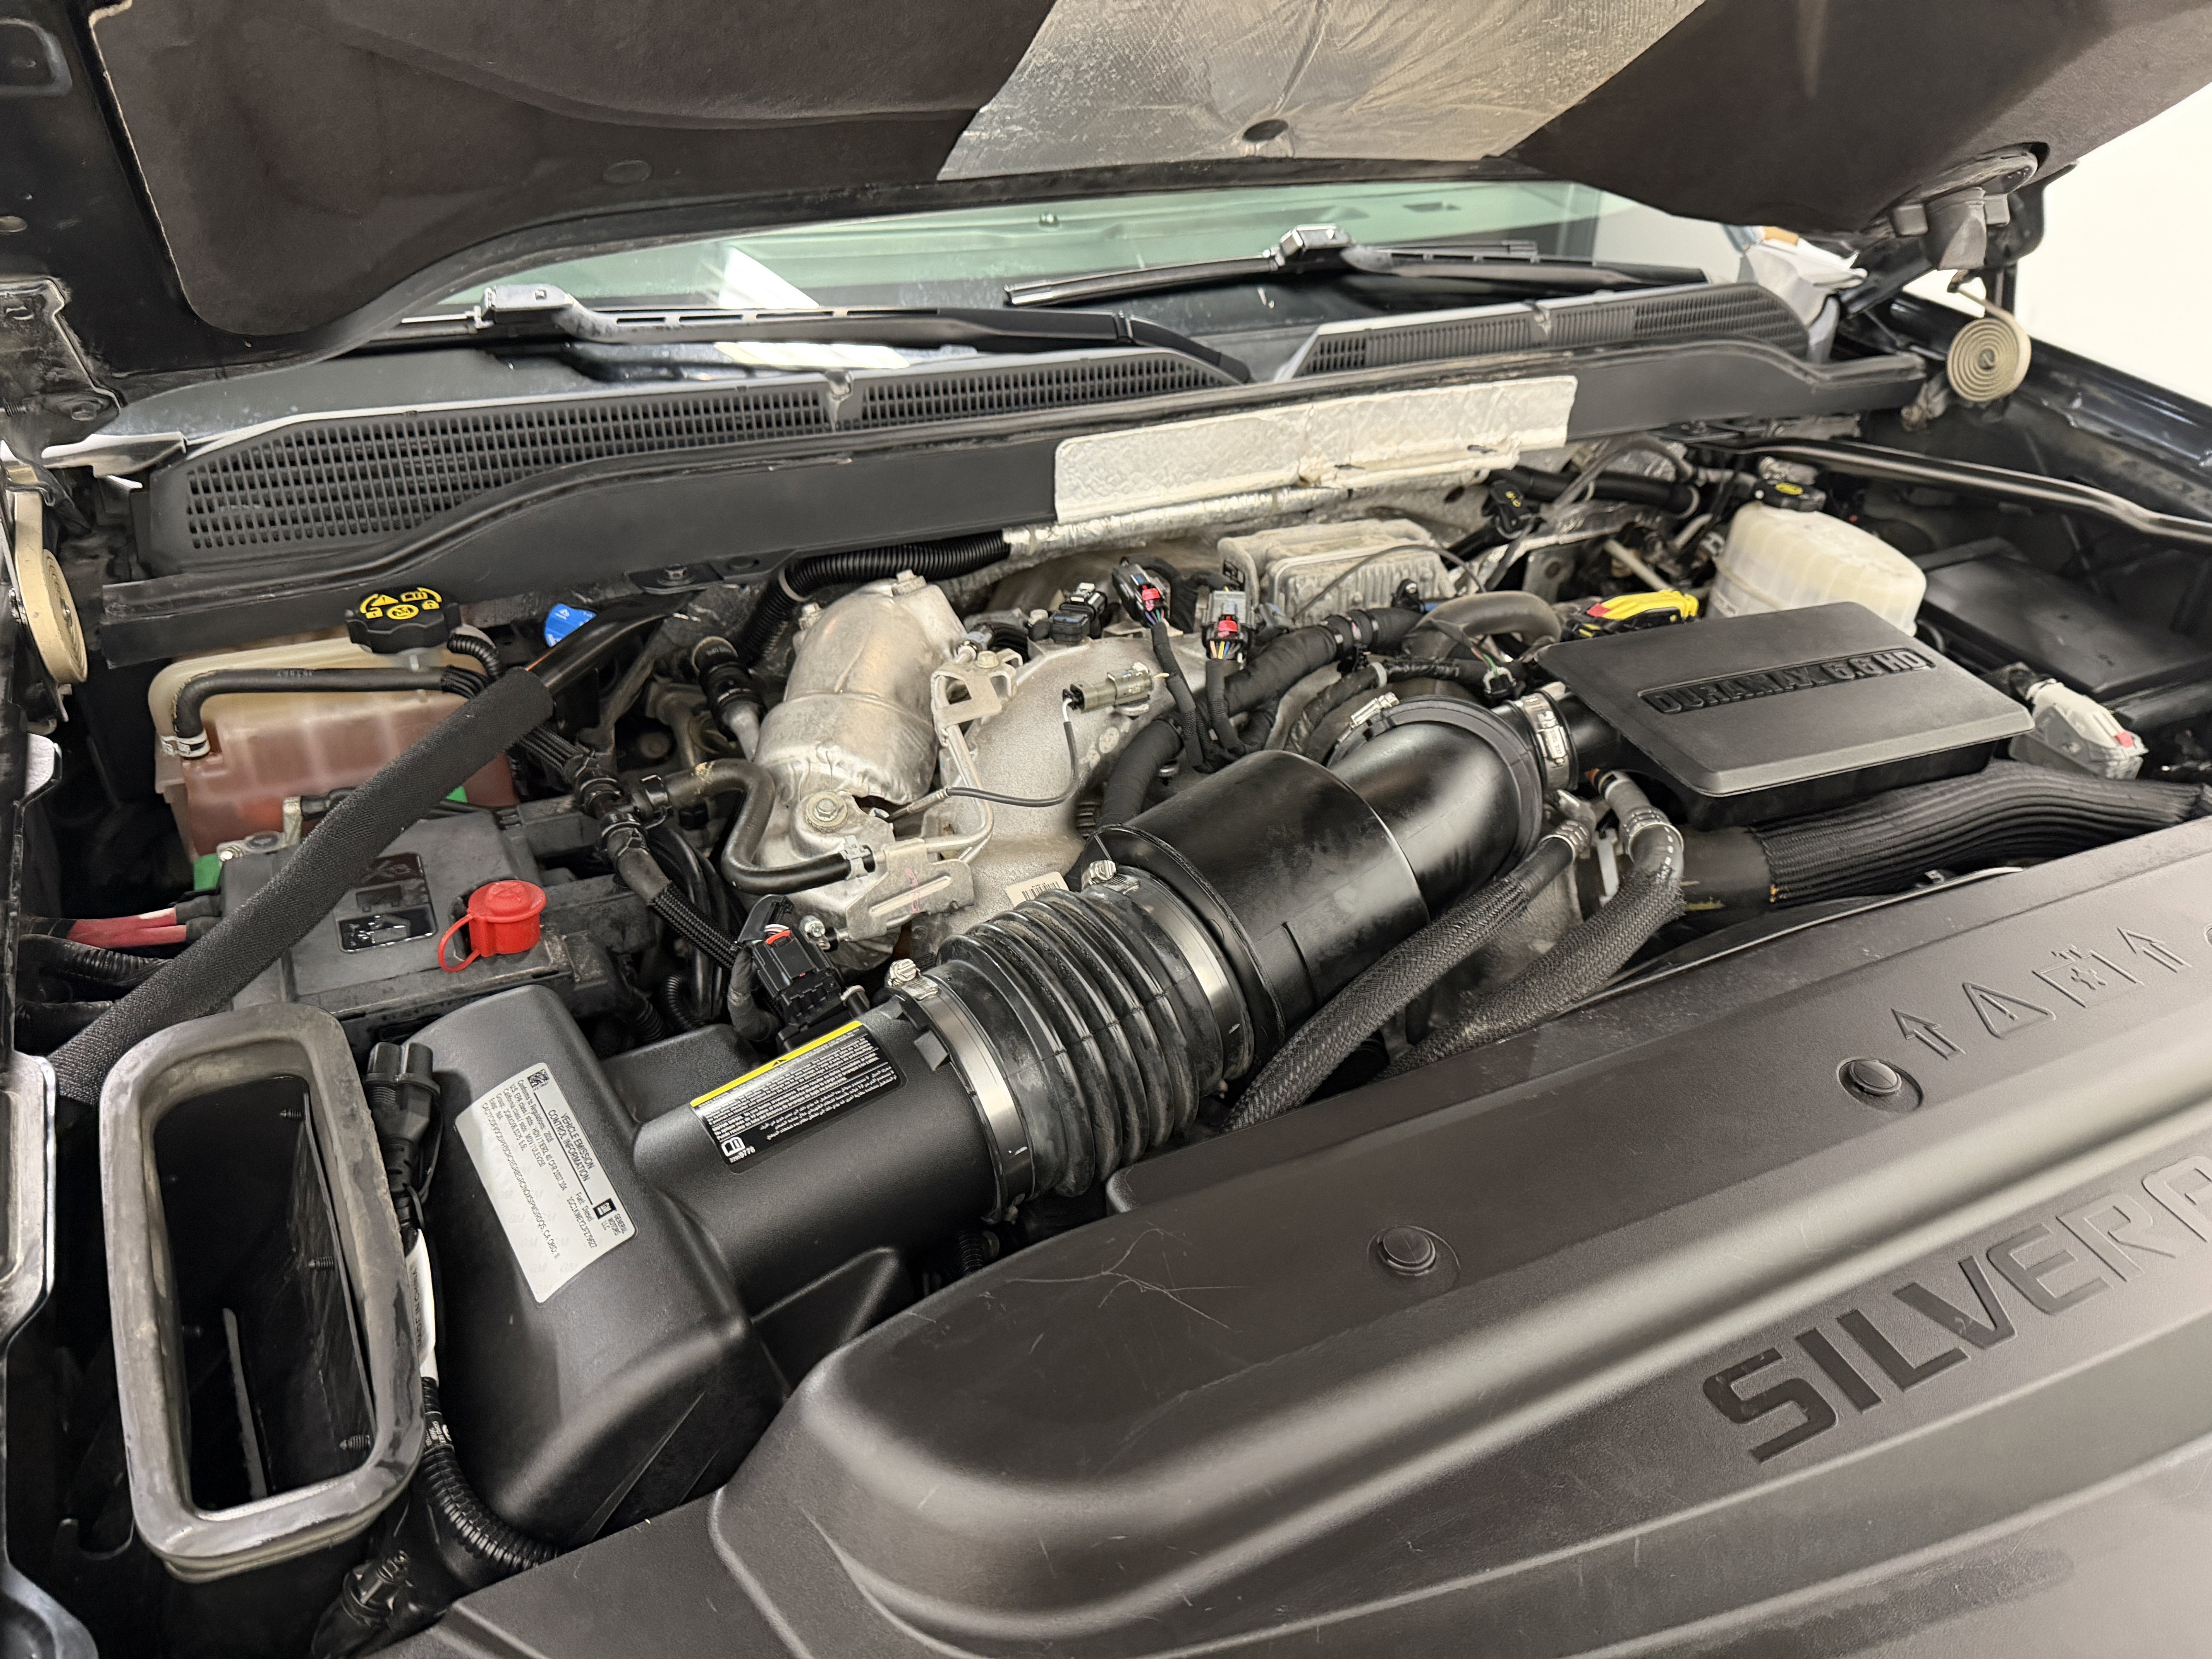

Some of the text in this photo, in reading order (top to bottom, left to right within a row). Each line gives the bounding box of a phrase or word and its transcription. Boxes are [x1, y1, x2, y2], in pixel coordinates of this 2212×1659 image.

[1651, 651, 1927, 714] DURAMAX 6.6 HD
[495, 1093, 507, 1109] Group:
[502, 1088, 517, 1109] California
[512, 1107, 522, 1120] class
[517, 1079, 532, 1101] Conforms
[528, 1103, 547, 1132] Regulations:
[544, 1130, 554, 1143] 2018
[514, 1092, 522, 1103] EPA
[519, 1101, 528, 1114] class
[531, 1127, 540, 1139] HDV
[548, 1159, 557, 1171] CFR
[560, 1113, 595, 1170] VEHICLE EMISSION
[547, 1109, 590, 1182] CONTROL INFORMATION
[582, 1205, 594, 1223] Diesel
[601, 1220, 610, 1231] LLC
[607, 1216, 620, 1236] MOTORS
[613, 1213, 628, 1234] GENERAL
[543, 1229, 551, 1240] CA
